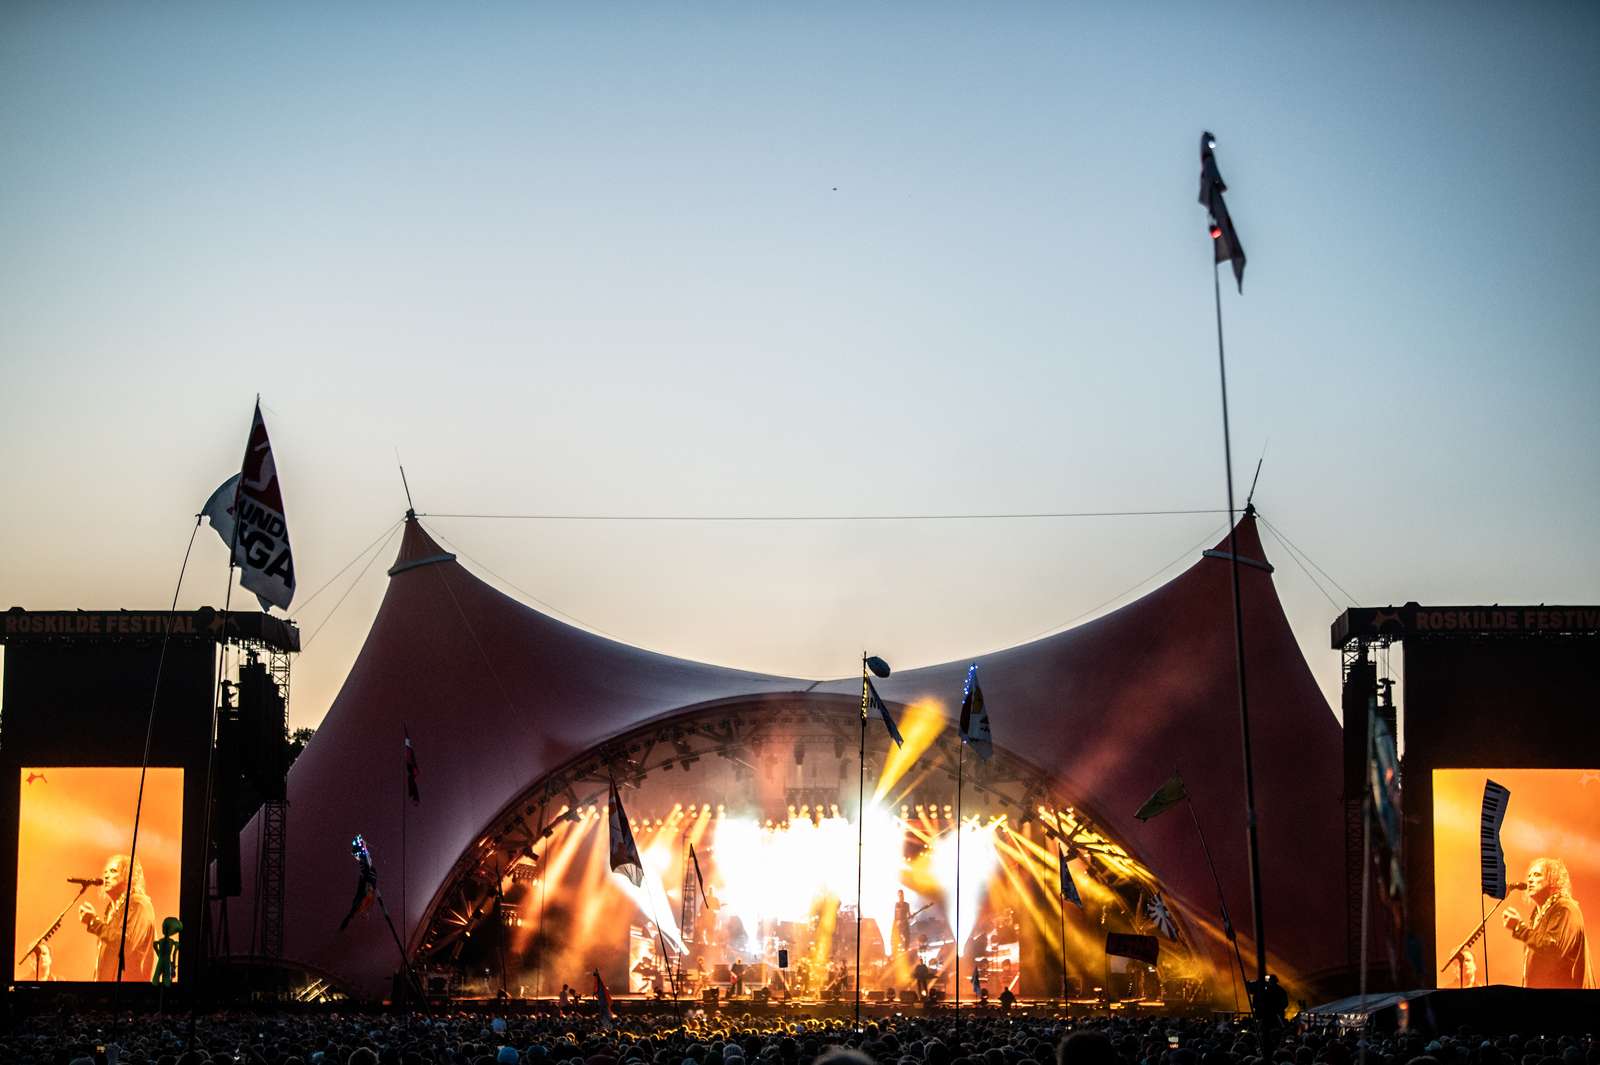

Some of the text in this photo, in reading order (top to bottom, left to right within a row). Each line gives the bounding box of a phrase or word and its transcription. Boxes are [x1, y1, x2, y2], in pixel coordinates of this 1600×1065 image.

[5, 615, 196, 634] ROSKILDE FESTIVAL
[1415, 609, 1600, 630] ROSKILDE FESTIV
